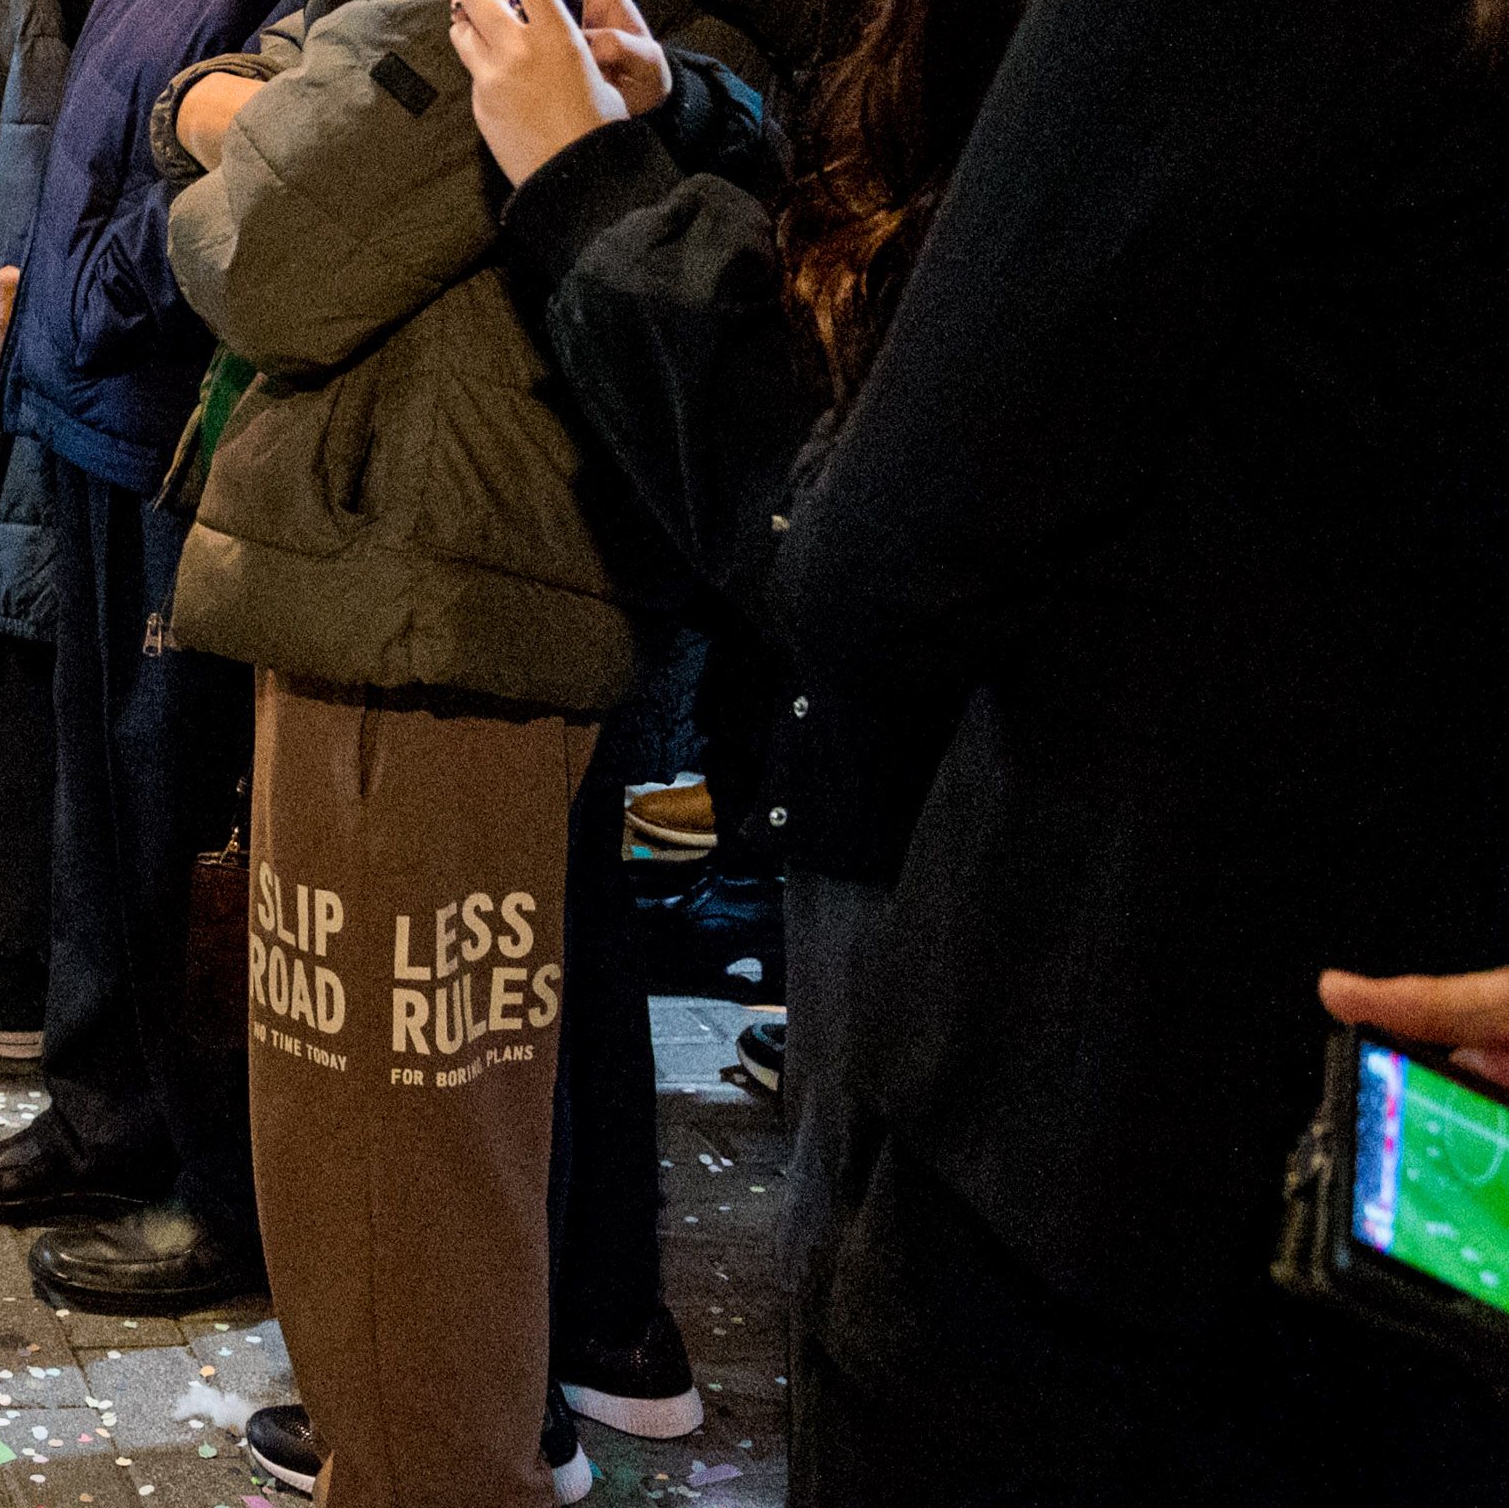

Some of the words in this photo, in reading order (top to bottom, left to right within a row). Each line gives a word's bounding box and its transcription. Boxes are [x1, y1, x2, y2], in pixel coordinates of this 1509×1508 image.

[256, 860, 345, 957] SLIP
[393, 891, 537, 981] LESS
[248, 931, 346, 1035] ROAD
[392, 963, 562, 1056] RULES
[271, 1029, 302, 1057] TIME
[306, 1043, 348, 1072] TODAY
[391, 1067, 425, 1086] FOR
[486, 1044, 535, 1068] PLANS
